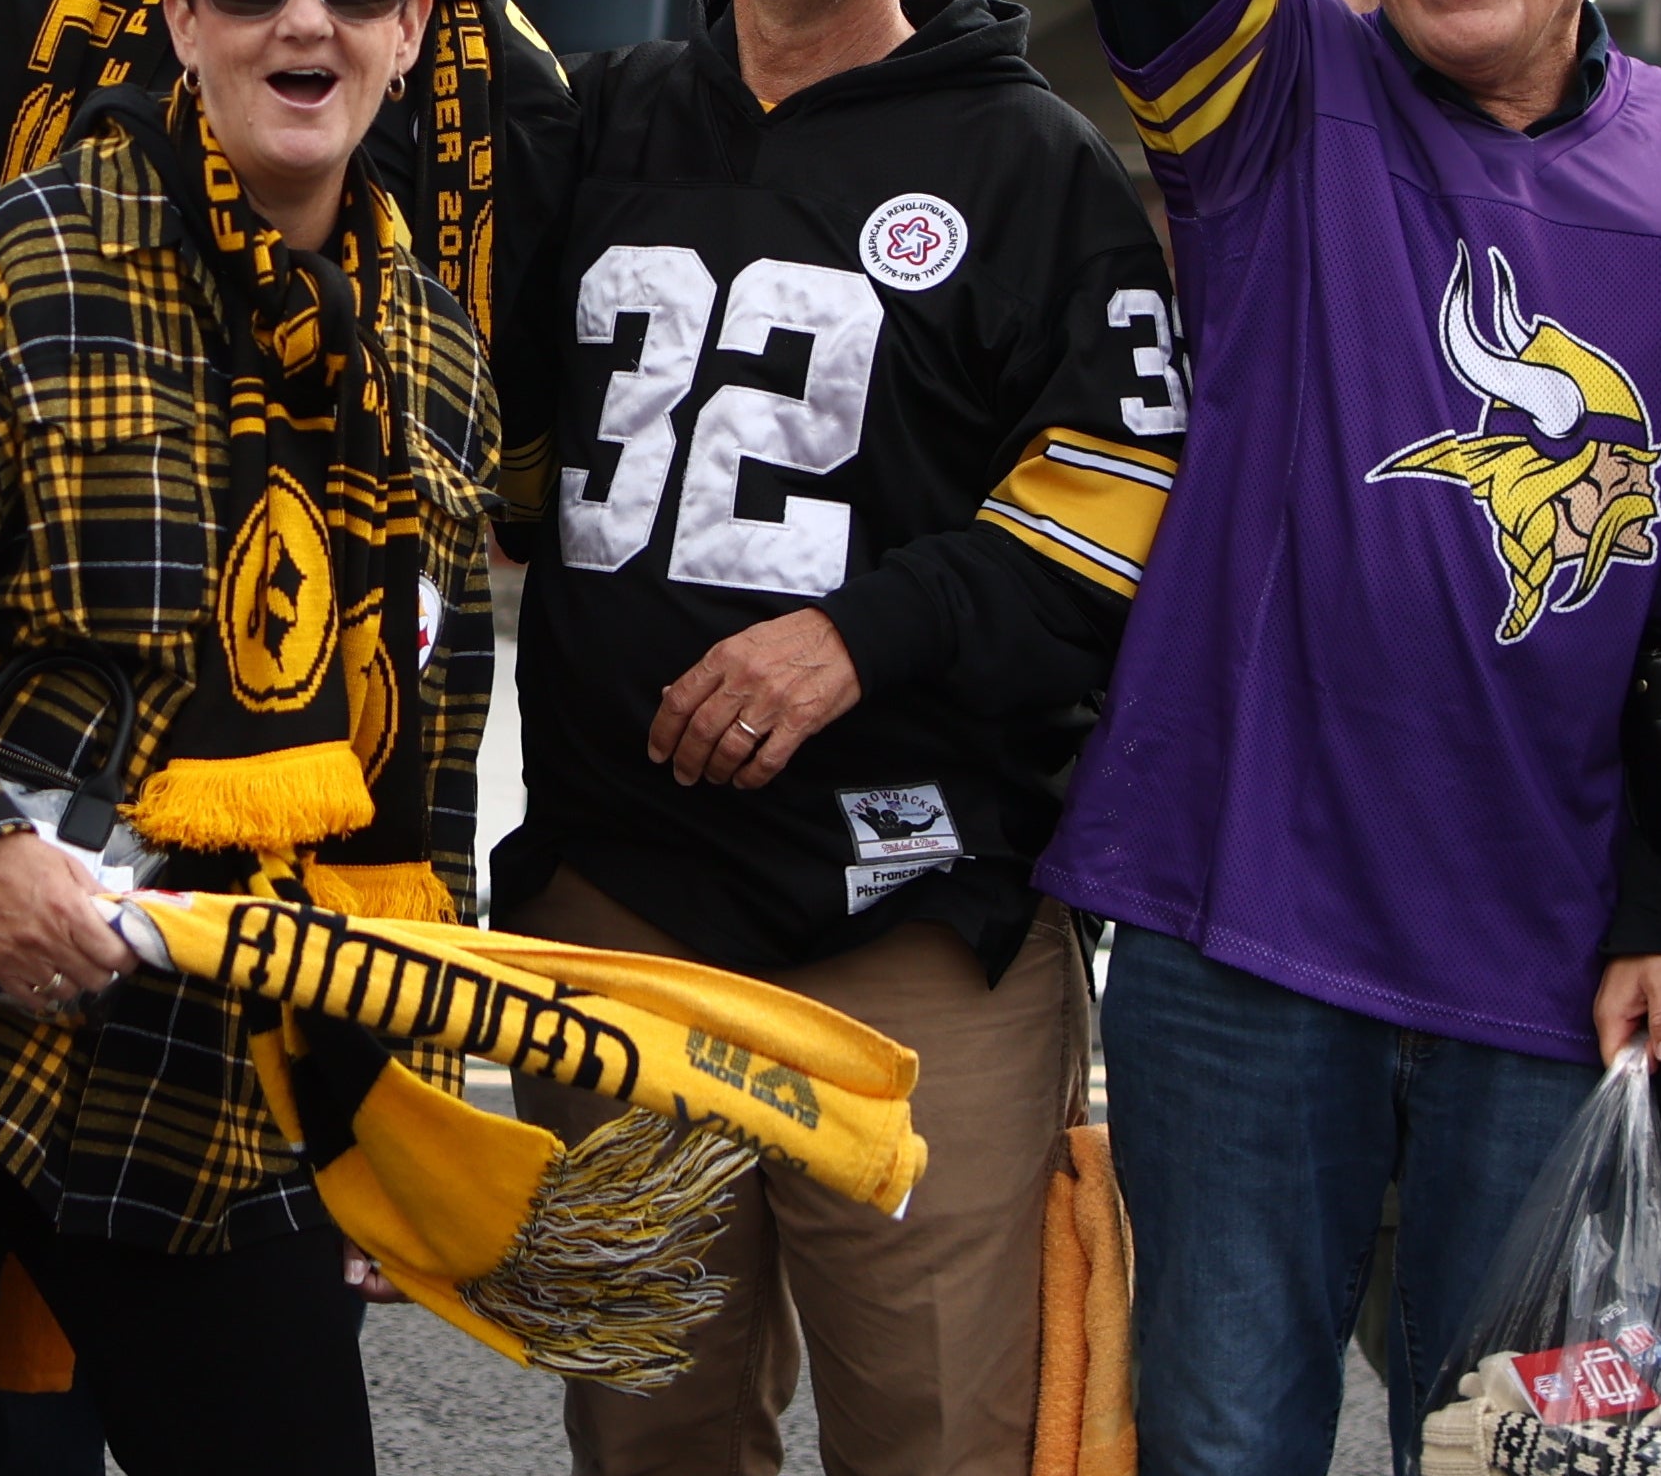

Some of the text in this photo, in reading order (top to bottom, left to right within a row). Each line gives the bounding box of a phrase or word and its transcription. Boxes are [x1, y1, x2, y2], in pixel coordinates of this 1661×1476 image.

[438, 190, 462, 305] 202
[868, 201, 958, 279] AMERICAN REVOLUTION BICENTENNIAL
[559, 243, 885, 597] 32
[1106, 287, 1192, 438] 3
[873, 868, 917, 883] Franco
